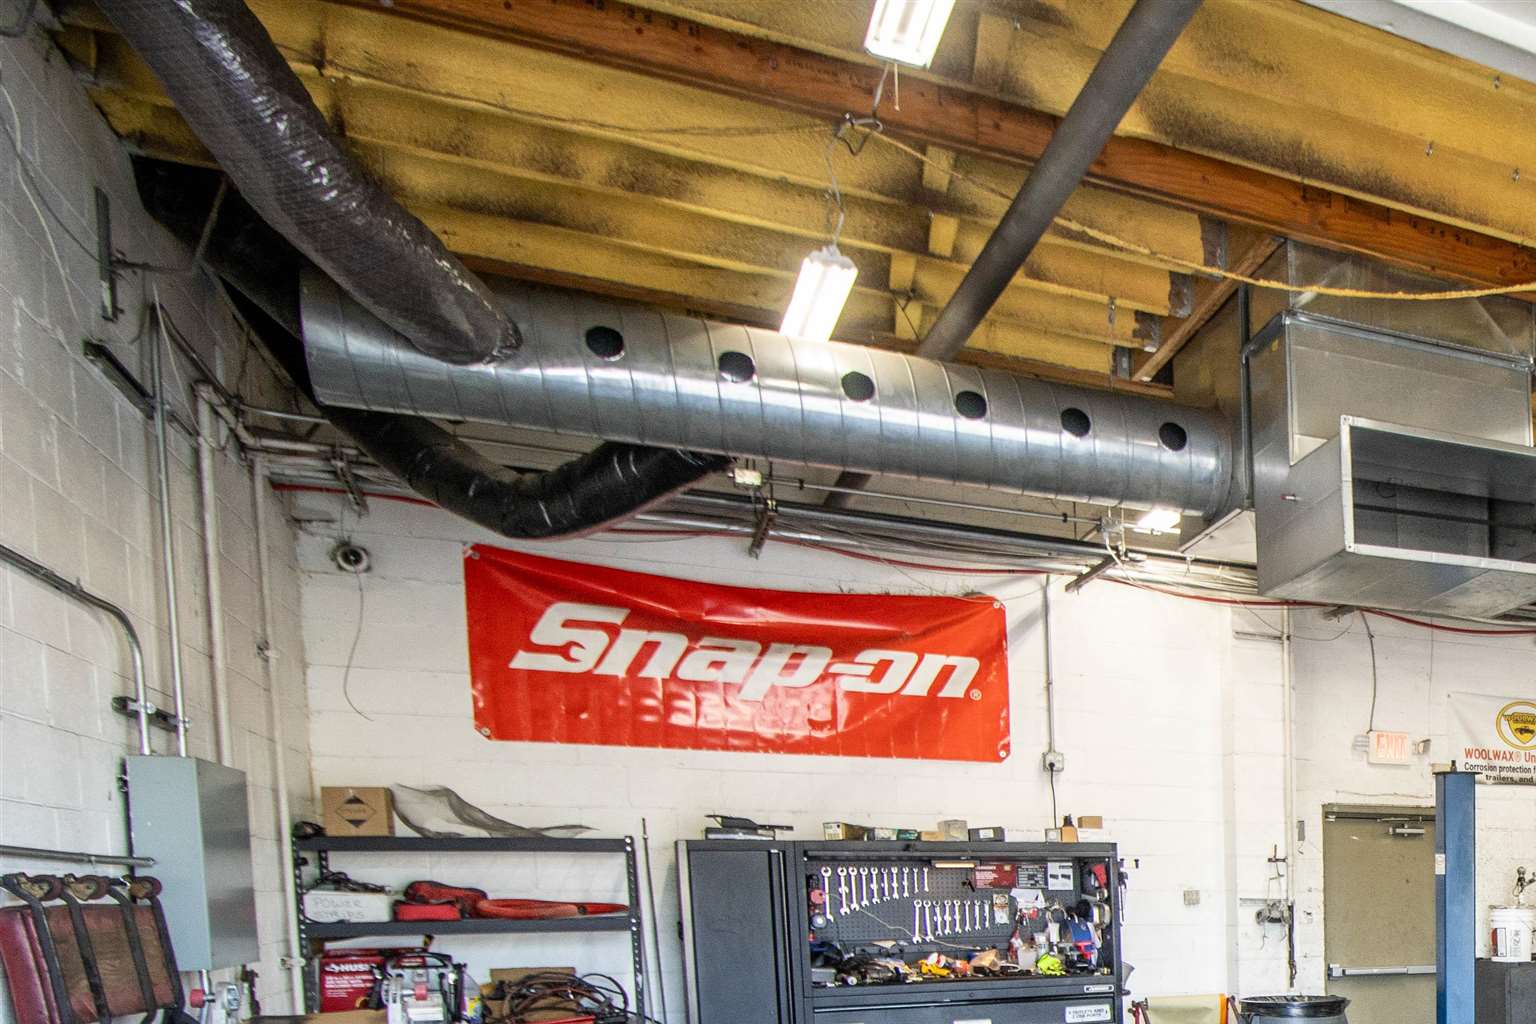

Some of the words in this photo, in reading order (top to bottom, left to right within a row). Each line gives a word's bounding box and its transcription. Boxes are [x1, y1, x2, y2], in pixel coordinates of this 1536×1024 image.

[1464, 762, 1498, 772] Corrosion
[1498, 765, 1532, 775] protection
[1485, 773, 1517, 784] trailers,
[1519, 775, 1534, 784] and
